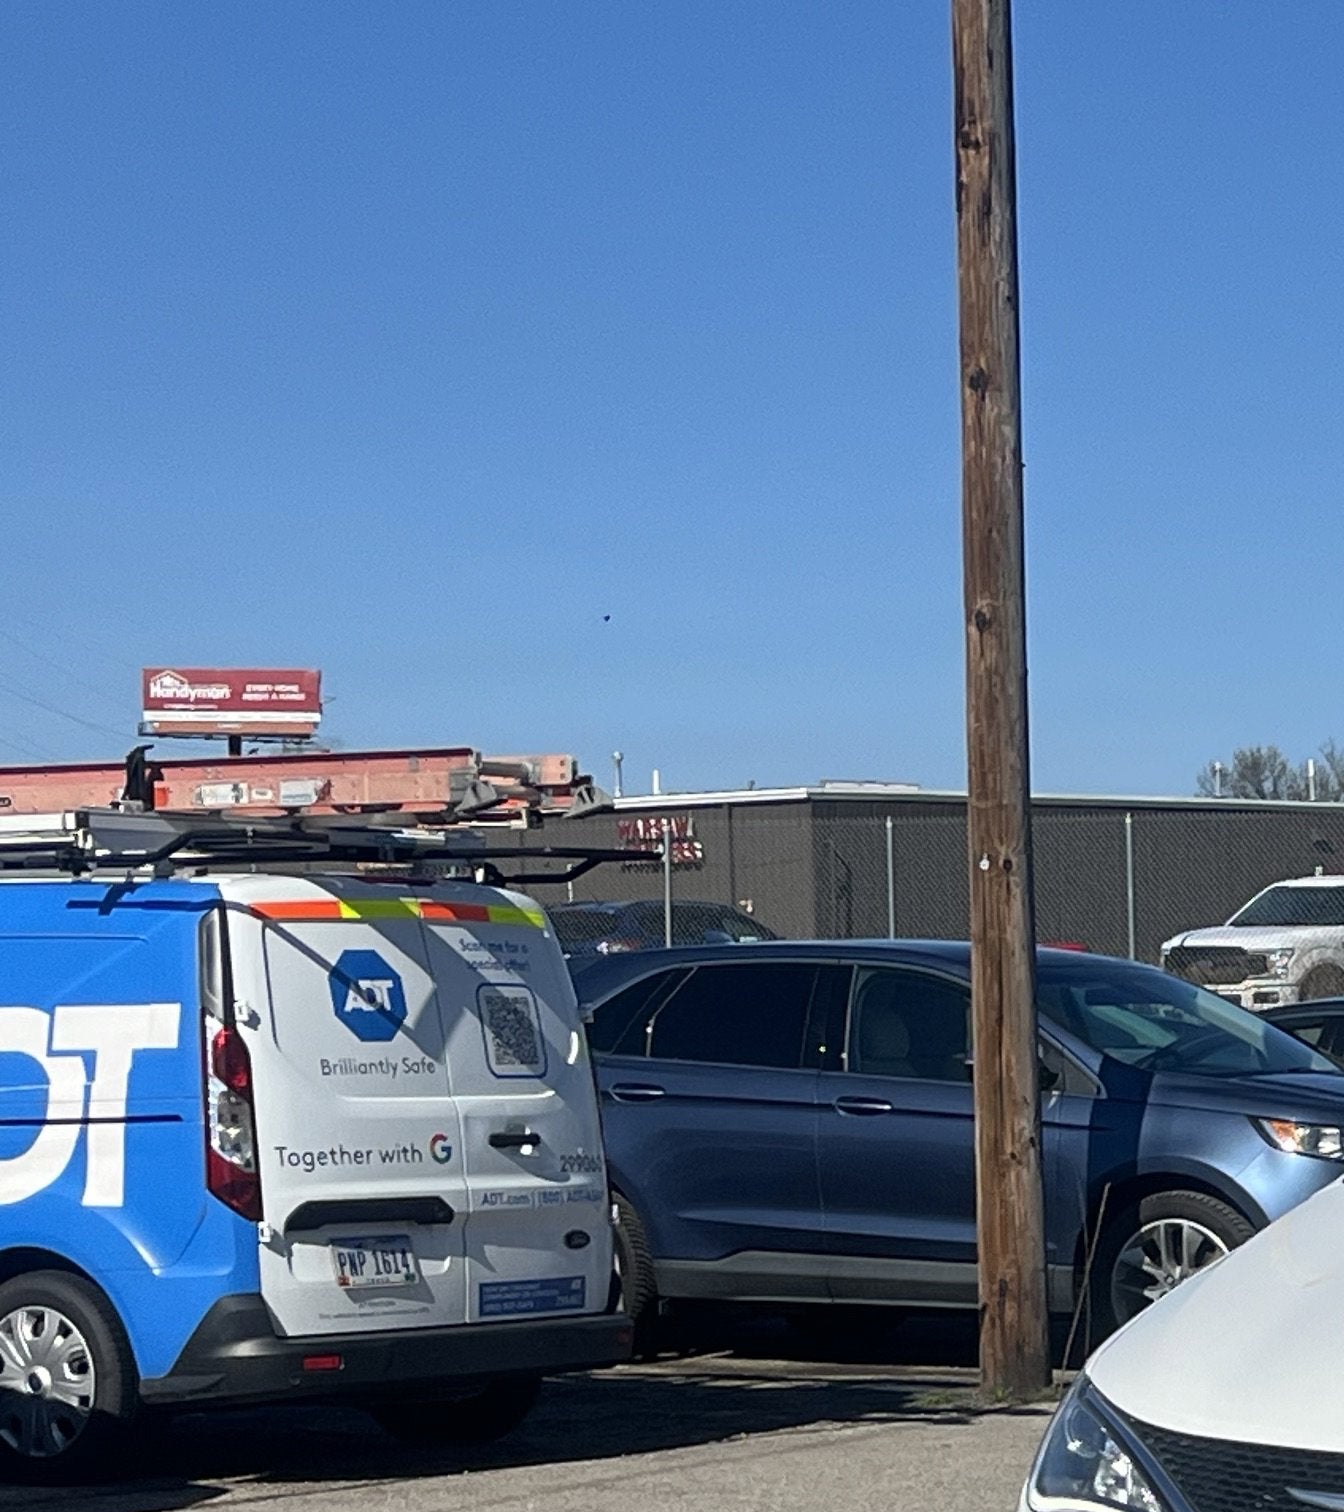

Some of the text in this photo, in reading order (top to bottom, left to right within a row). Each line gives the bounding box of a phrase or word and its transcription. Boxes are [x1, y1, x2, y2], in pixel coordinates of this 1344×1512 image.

[343, 979, 395, 1013] ADT
[320, 1055, 436, 1078] Brilliantly Safe
[274, 1144, 374, 1173] Together
[379, 1141, 424, 1164] with
[480, 1190, 531, 1207] ADT.com
[372, 1247, 412, 1276] 1614
